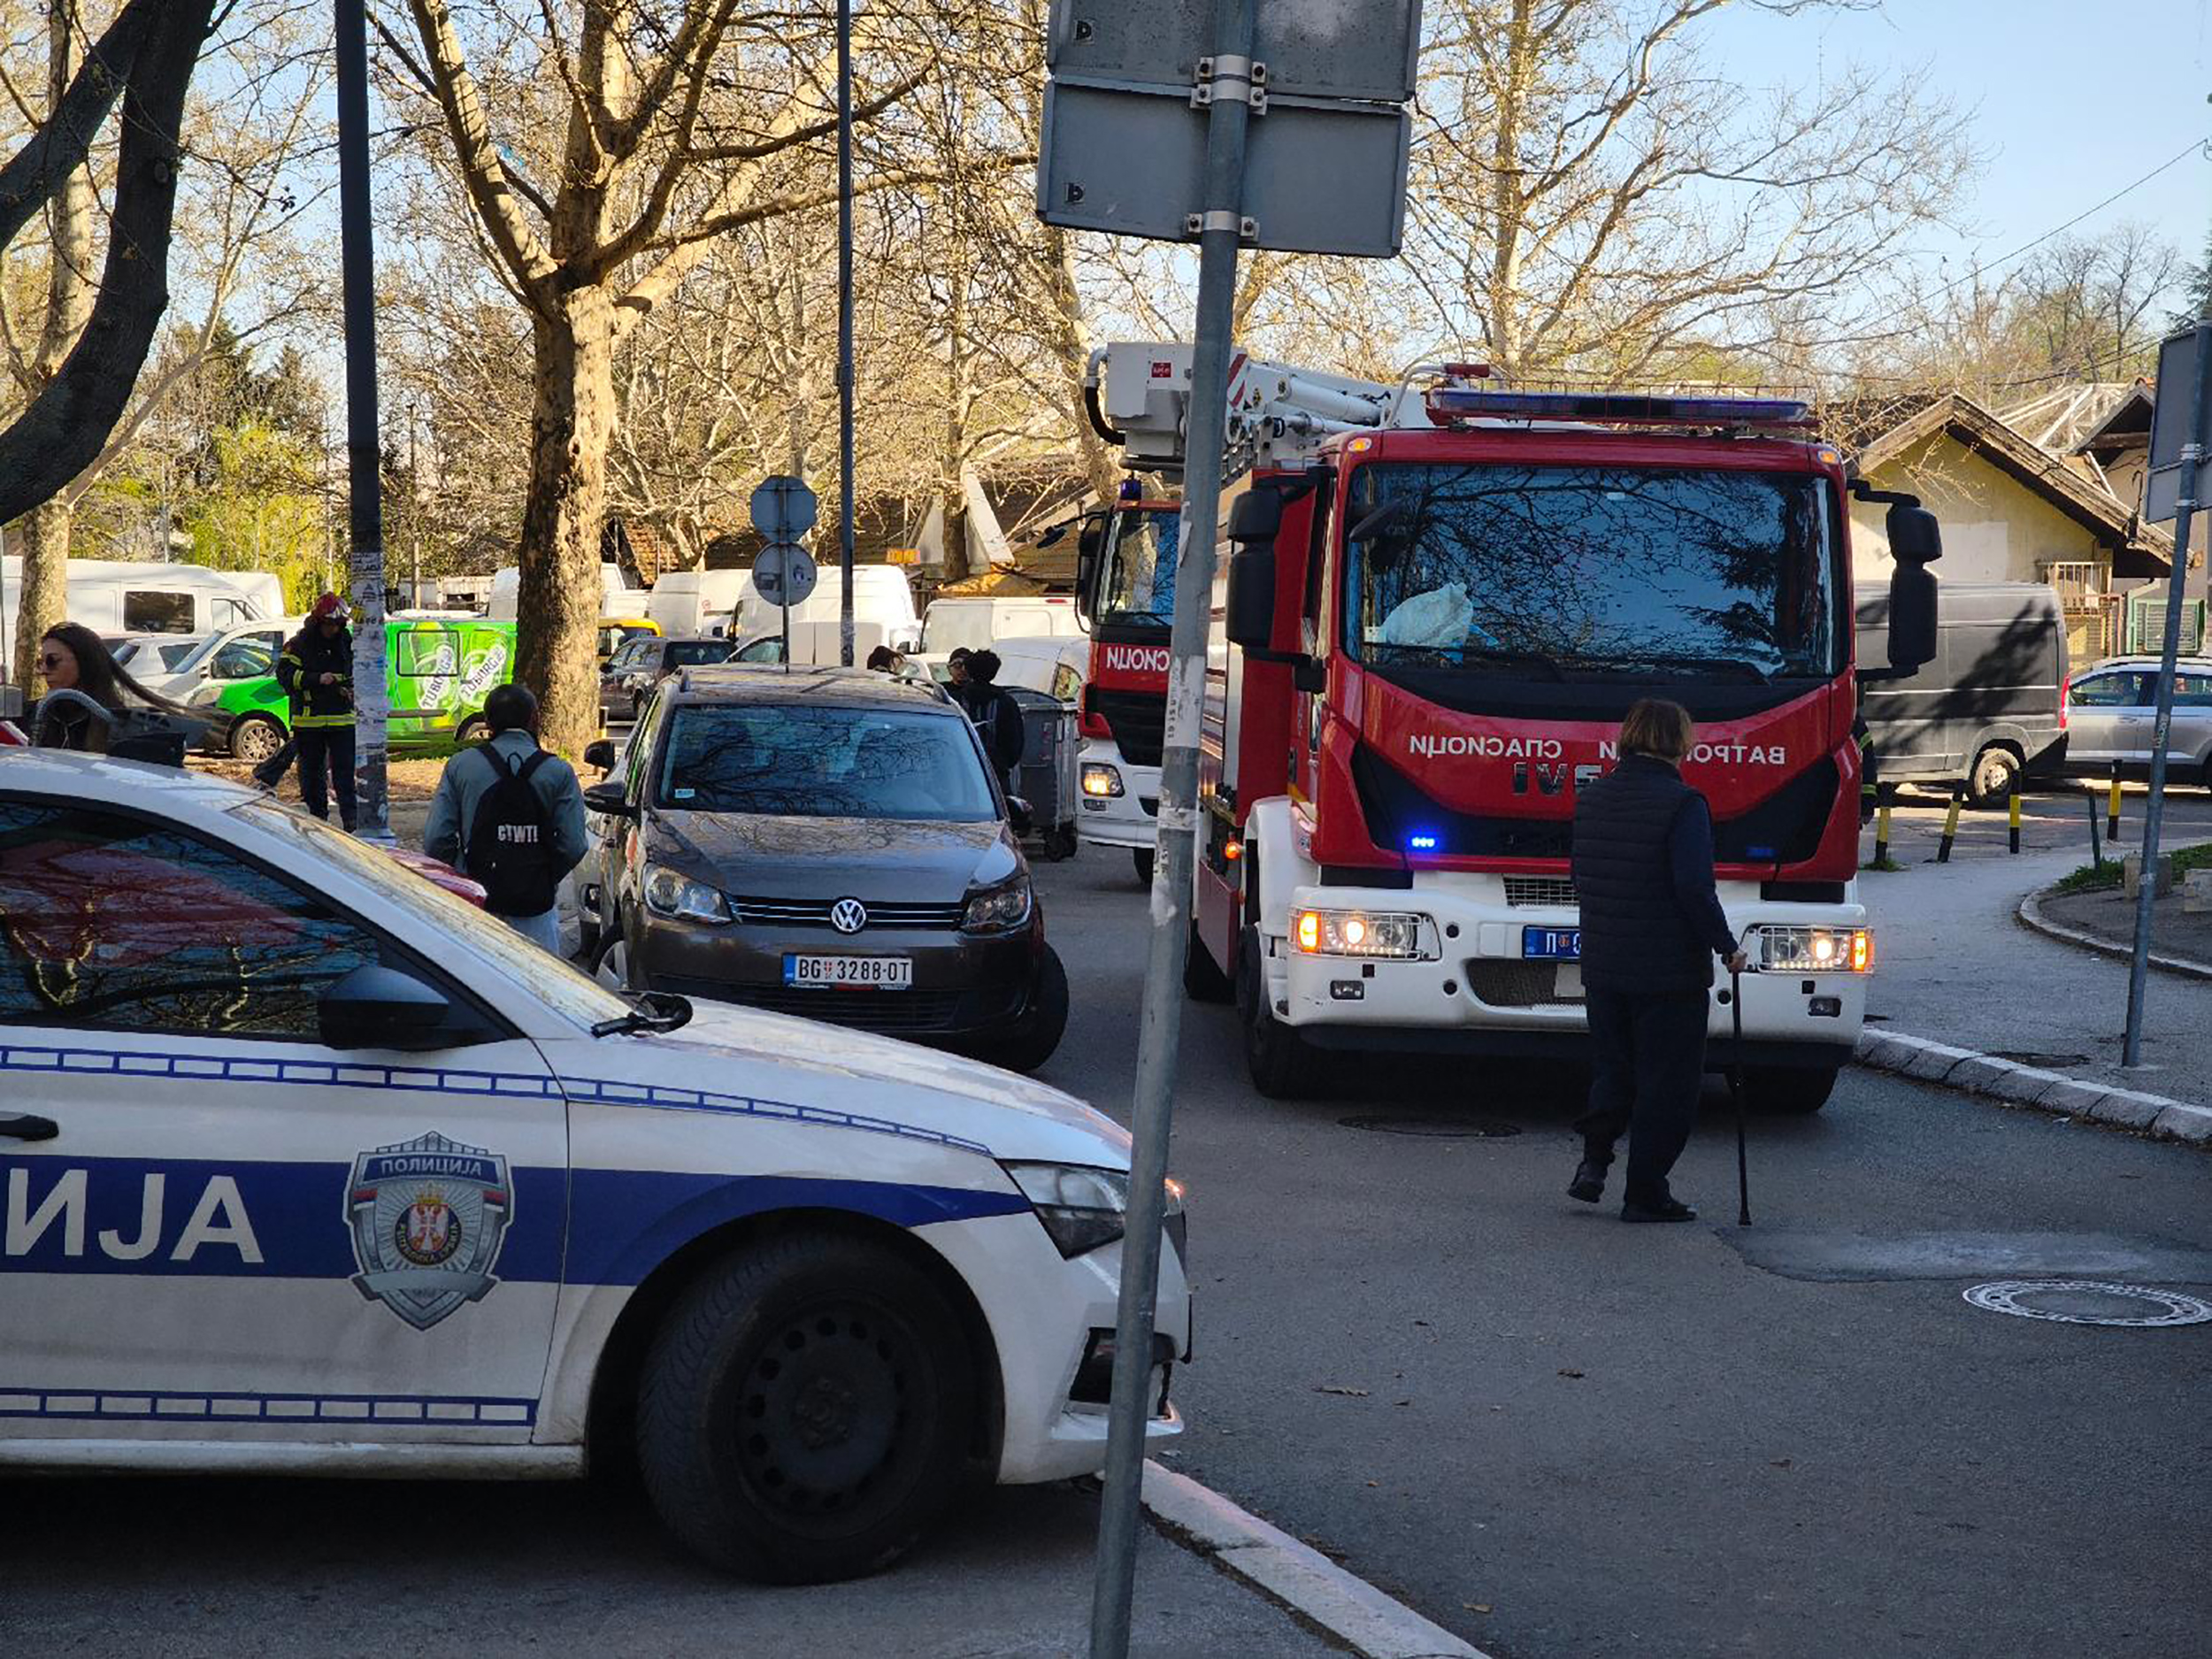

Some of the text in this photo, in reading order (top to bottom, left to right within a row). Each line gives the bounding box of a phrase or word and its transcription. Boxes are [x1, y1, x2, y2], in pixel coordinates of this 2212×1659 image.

[422, 657, 452, 708] TUBORG
[461, 656, 499, 697] TUBORG
[1512, 761, 1603, 796] IVE
[798, 958, 821, 979] BG
[380, 1157, 482, 1176] ПОЛИЦИЈА
